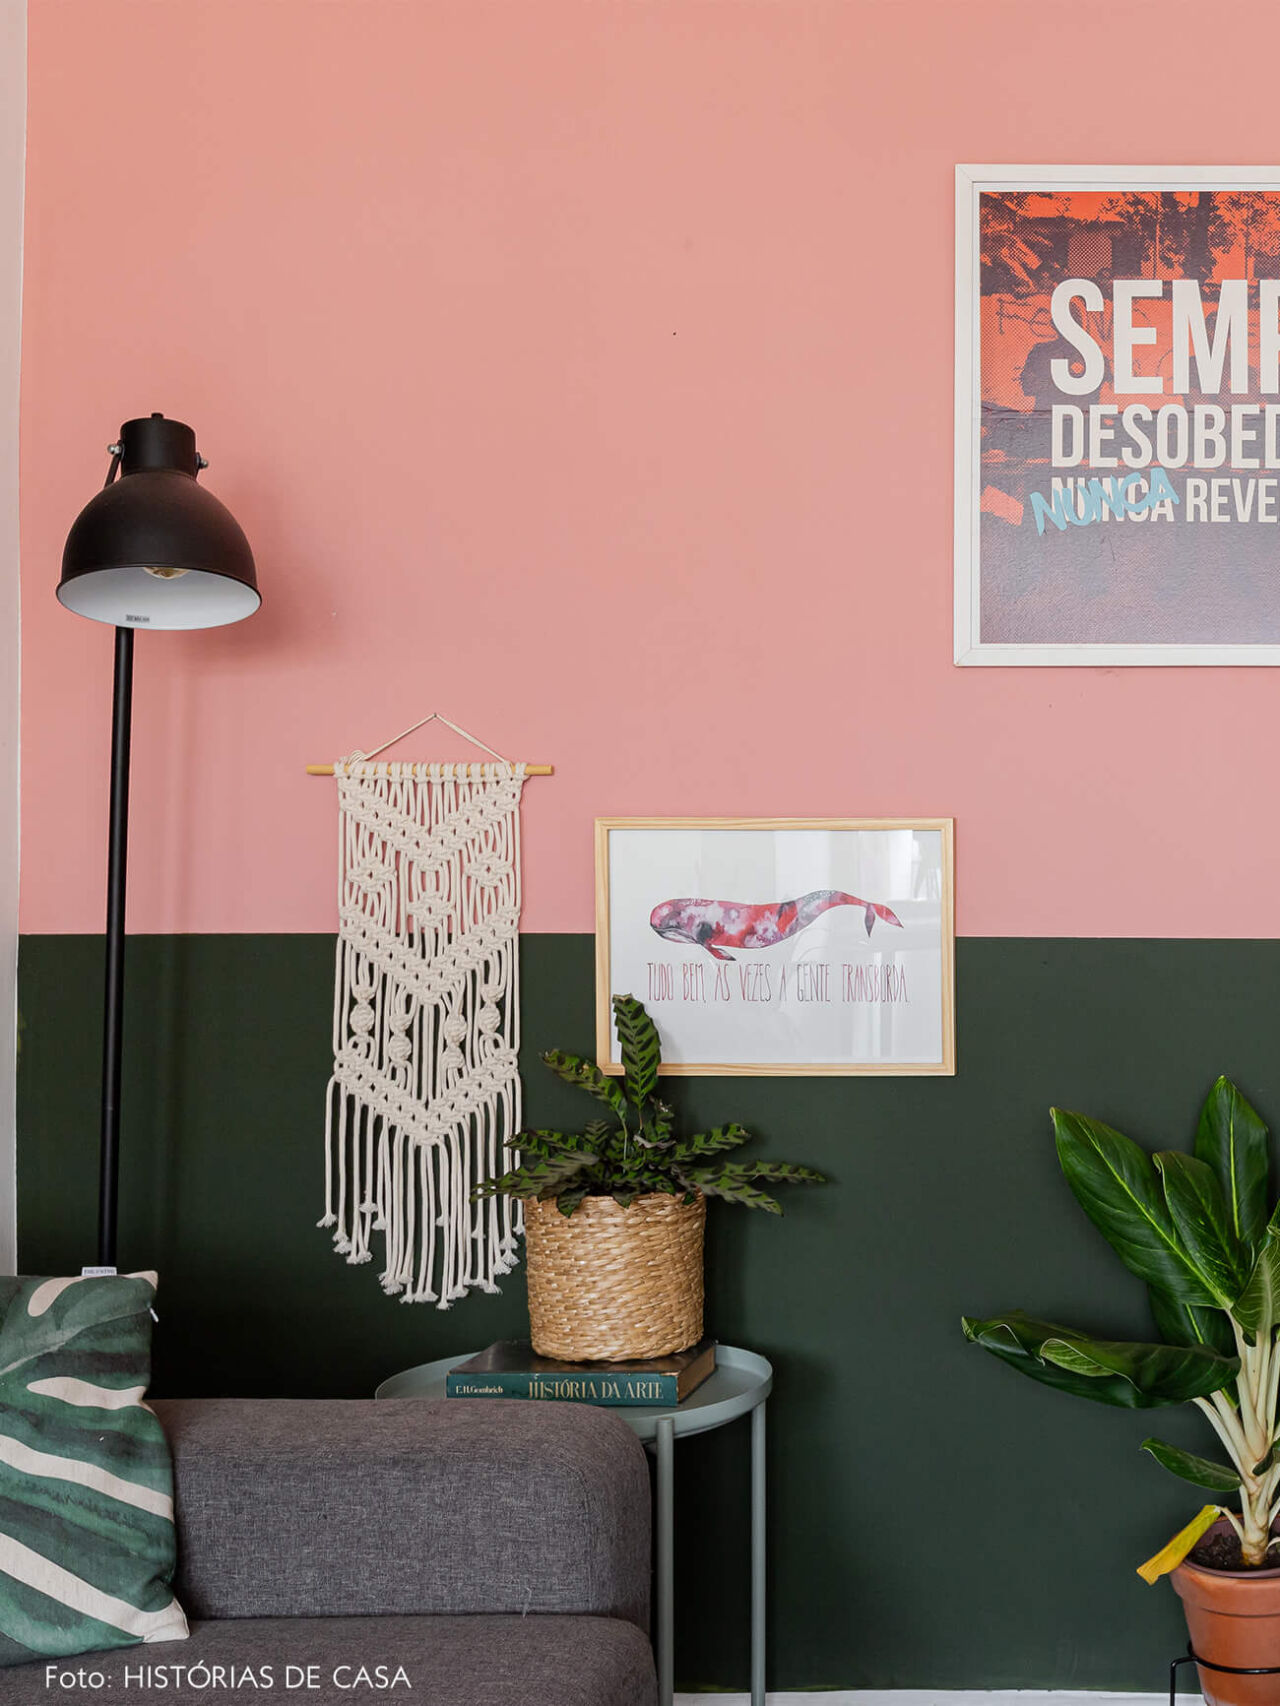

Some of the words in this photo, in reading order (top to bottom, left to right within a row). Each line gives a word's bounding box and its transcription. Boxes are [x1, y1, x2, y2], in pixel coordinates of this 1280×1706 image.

[1030, 467, 1180, 537] NUNCA
[647, 962, 674, 1001] TUDO
[739, 963, 771, 1002] VEZES
[779, 964, 787, 1001] A
[797, 964, 831, 1002] GENTE
[529, 1379, 598, 1399] HISTÓRIA
[601, 1382, 621, 1399] DA
[625, 1382, 663, 1399] ARTE
